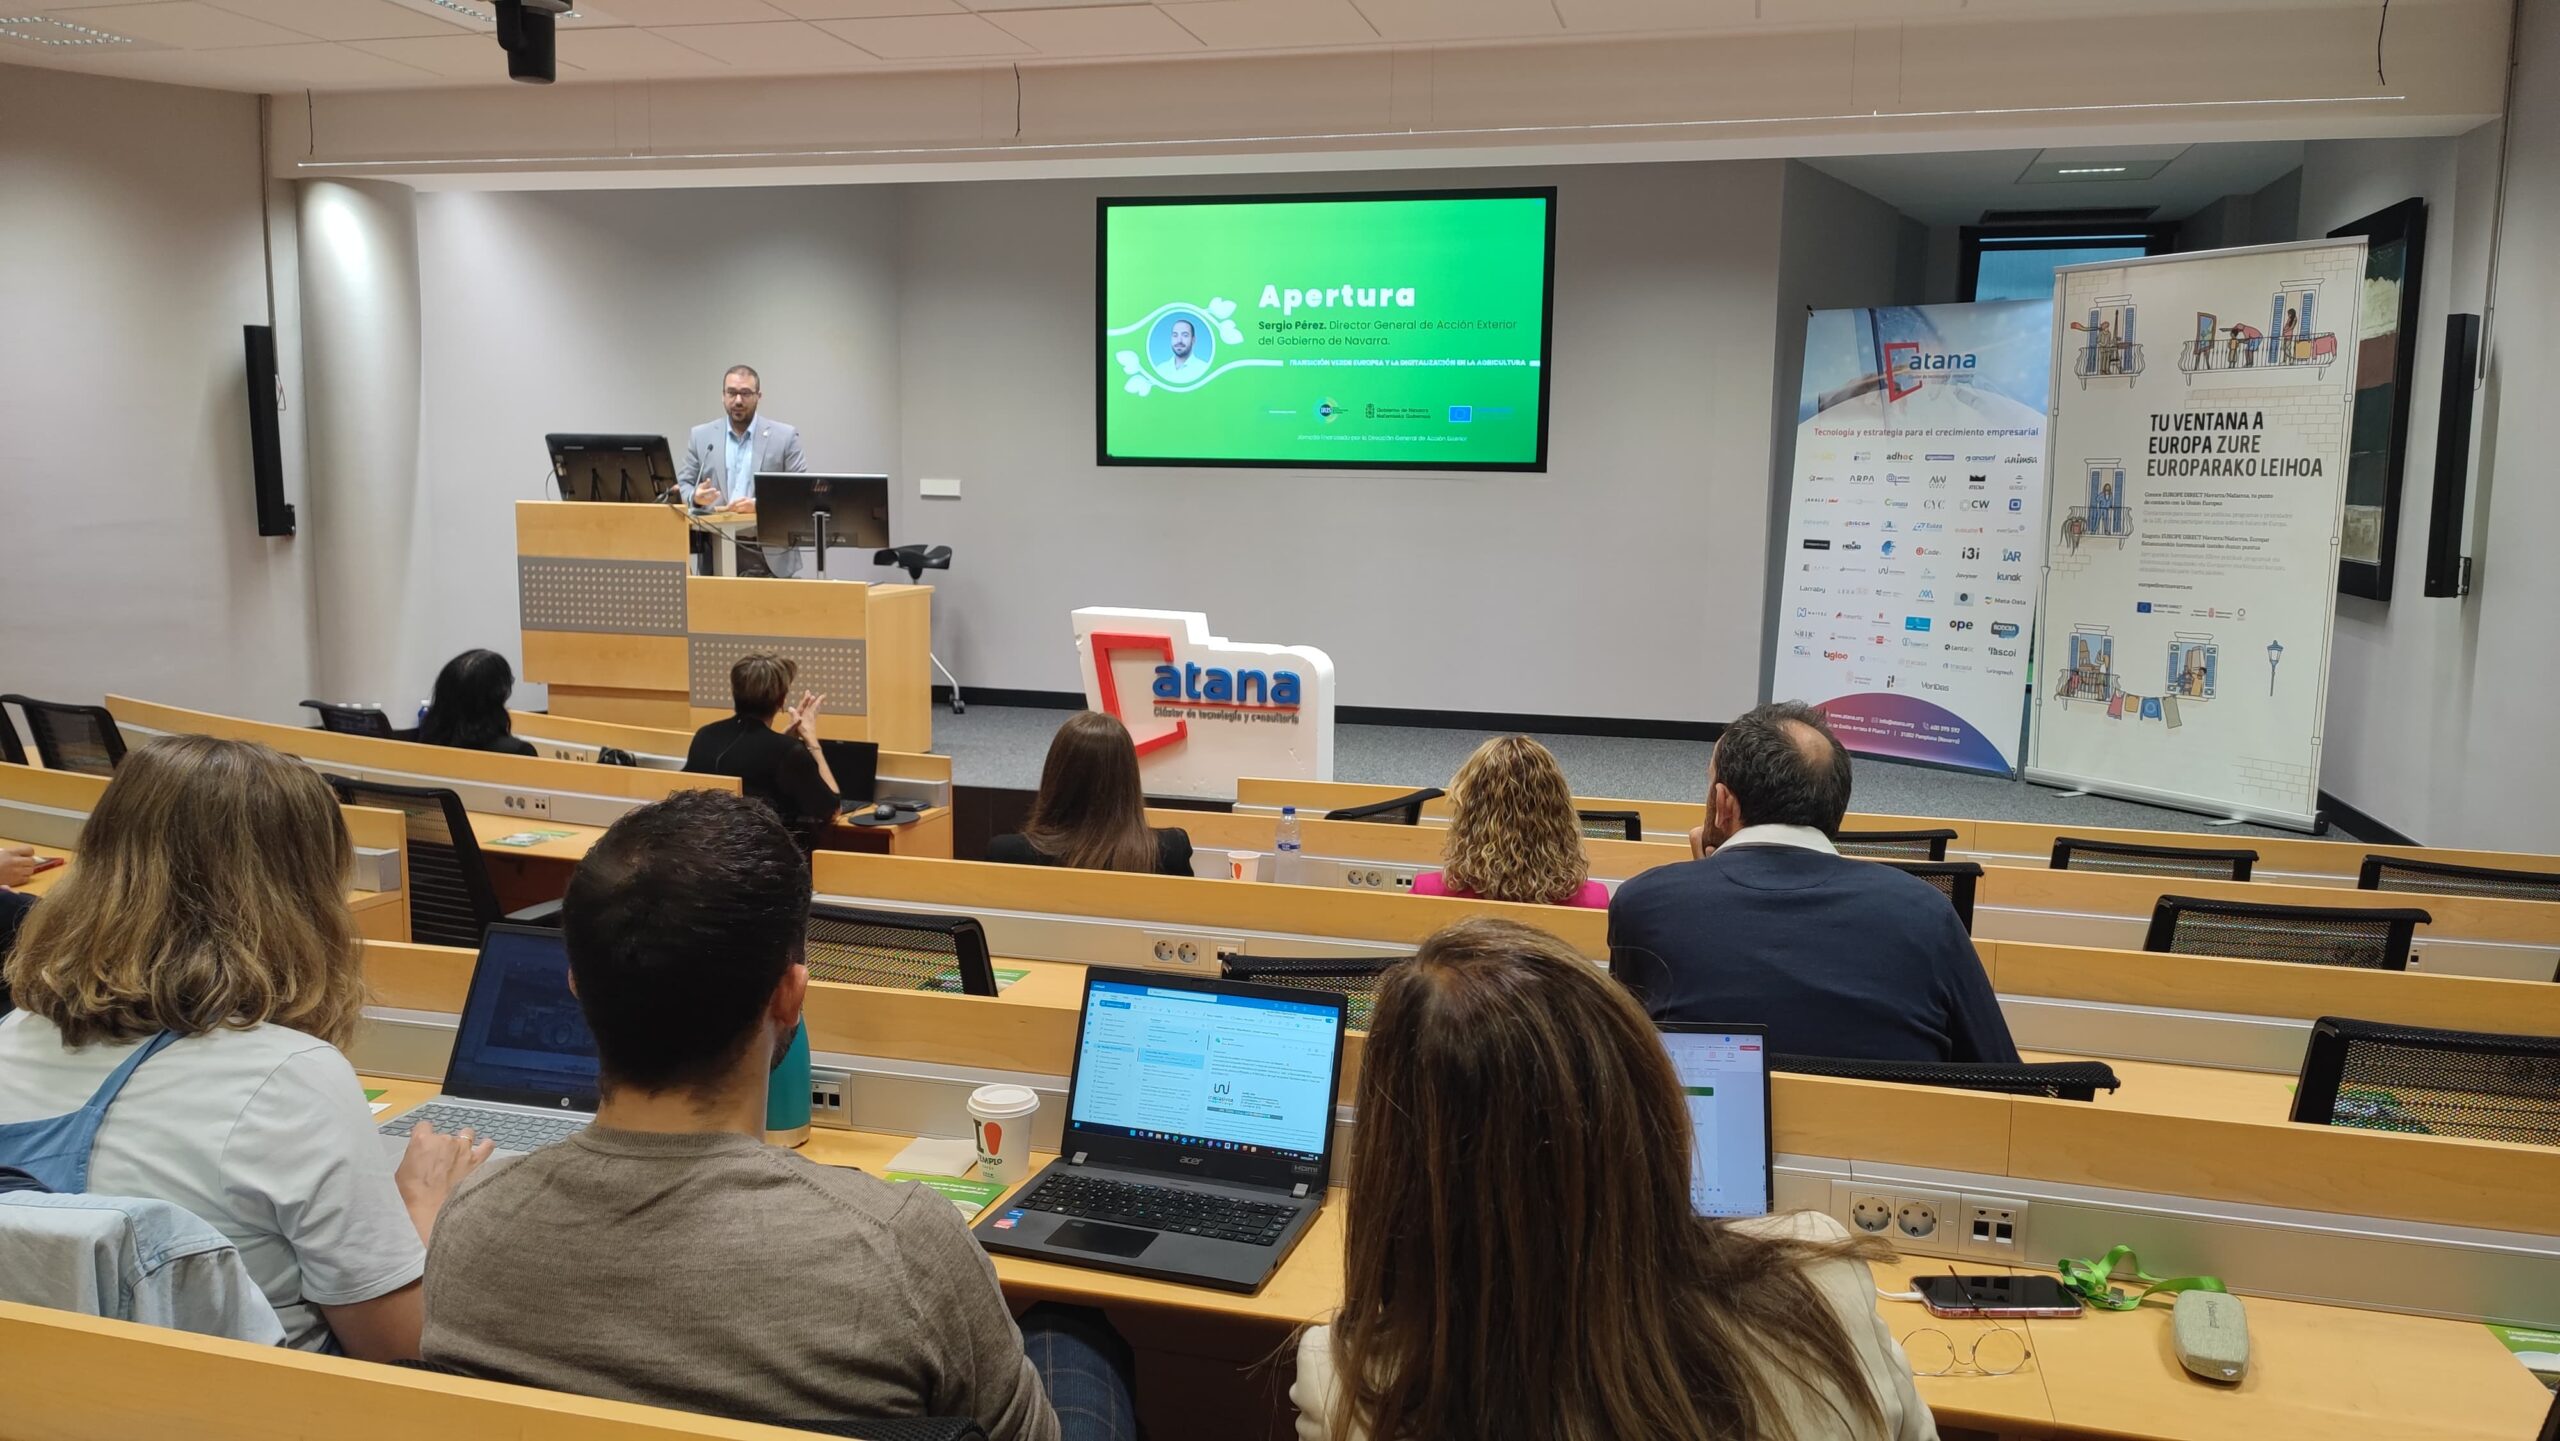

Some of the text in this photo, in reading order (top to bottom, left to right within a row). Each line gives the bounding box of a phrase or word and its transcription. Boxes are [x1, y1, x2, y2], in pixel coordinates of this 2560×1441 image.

[1258, 284, 1416, 316] Apertura
[1258, 319, 1517, 332] Sergio Pérez. Director General de Acción Exterior
[1258, 336, 1390, 346] del Gobierno de Navarra.
[1908, 352, 1976, 370] atana
[2150, 411, 2264, 432] TU VENTANA A
[1814, 428, 1854, 437] Tecnología
[1863, 428, 1902, 437] estrategia
[1926, 428, 1933, 436] el
[1935, 428, 1984, 436] crecimiento
[1986, 428, 2038, 438] empresarial
[2149, 434, 2261, 455] EUROPA ZURE
[1886, 452, 1914, 460] adhoc
[2147, 457, 2323, 478] EUROPARAKO LEIHOA
[1971, 500, 1990, 509] CW
[1962, 547, 1980, 560] i3i
[1949, 620, 1973, 631] ope
[1152, 661, 1300, 705] atana
[1154, 706, 1300, 724] Clúster de tecnología y consultoría
[1179, 1155, 1203, 1166] acer
